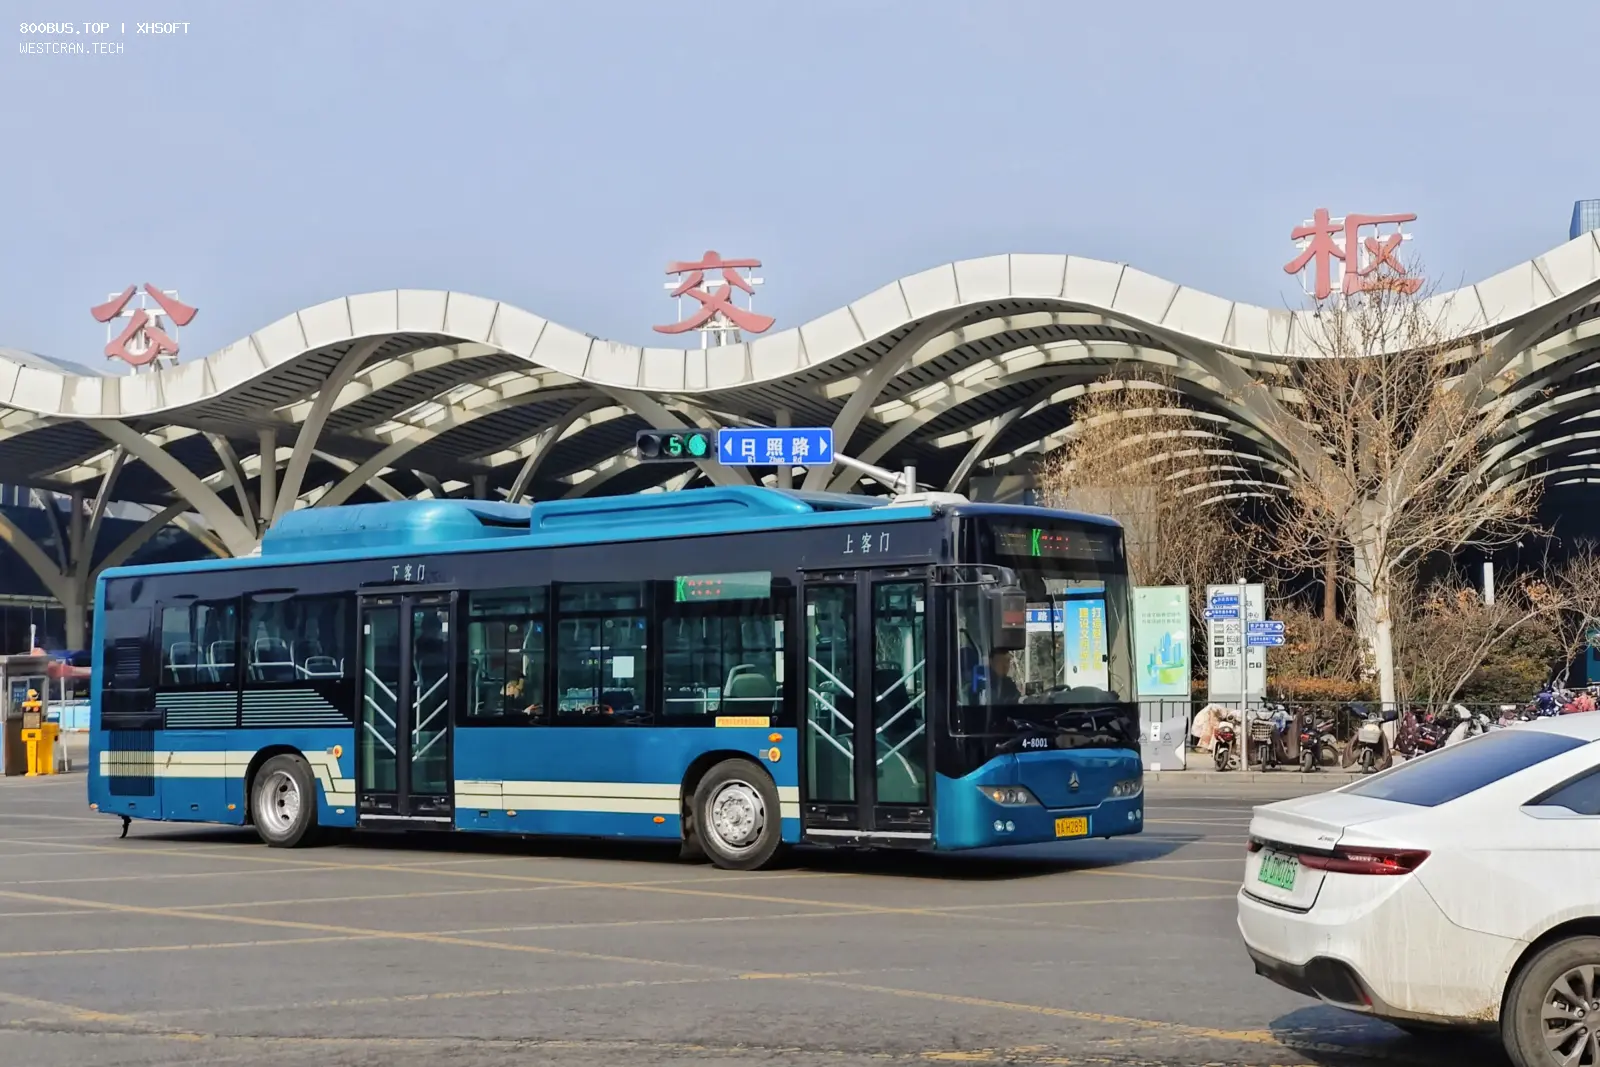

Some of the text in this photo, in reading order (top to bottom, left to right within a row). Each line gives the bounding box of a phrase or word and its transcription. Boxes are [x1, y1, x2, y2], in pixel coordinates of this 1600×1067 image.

[90, 207, 1426, 366] 公 交 枢
[741, 436, 810, 457] 日照路
[843, 532, 890, 554] 上客门
[391, 564, 426, 582] 下客门
[1022, 737, 1048, 748] 4-8001
